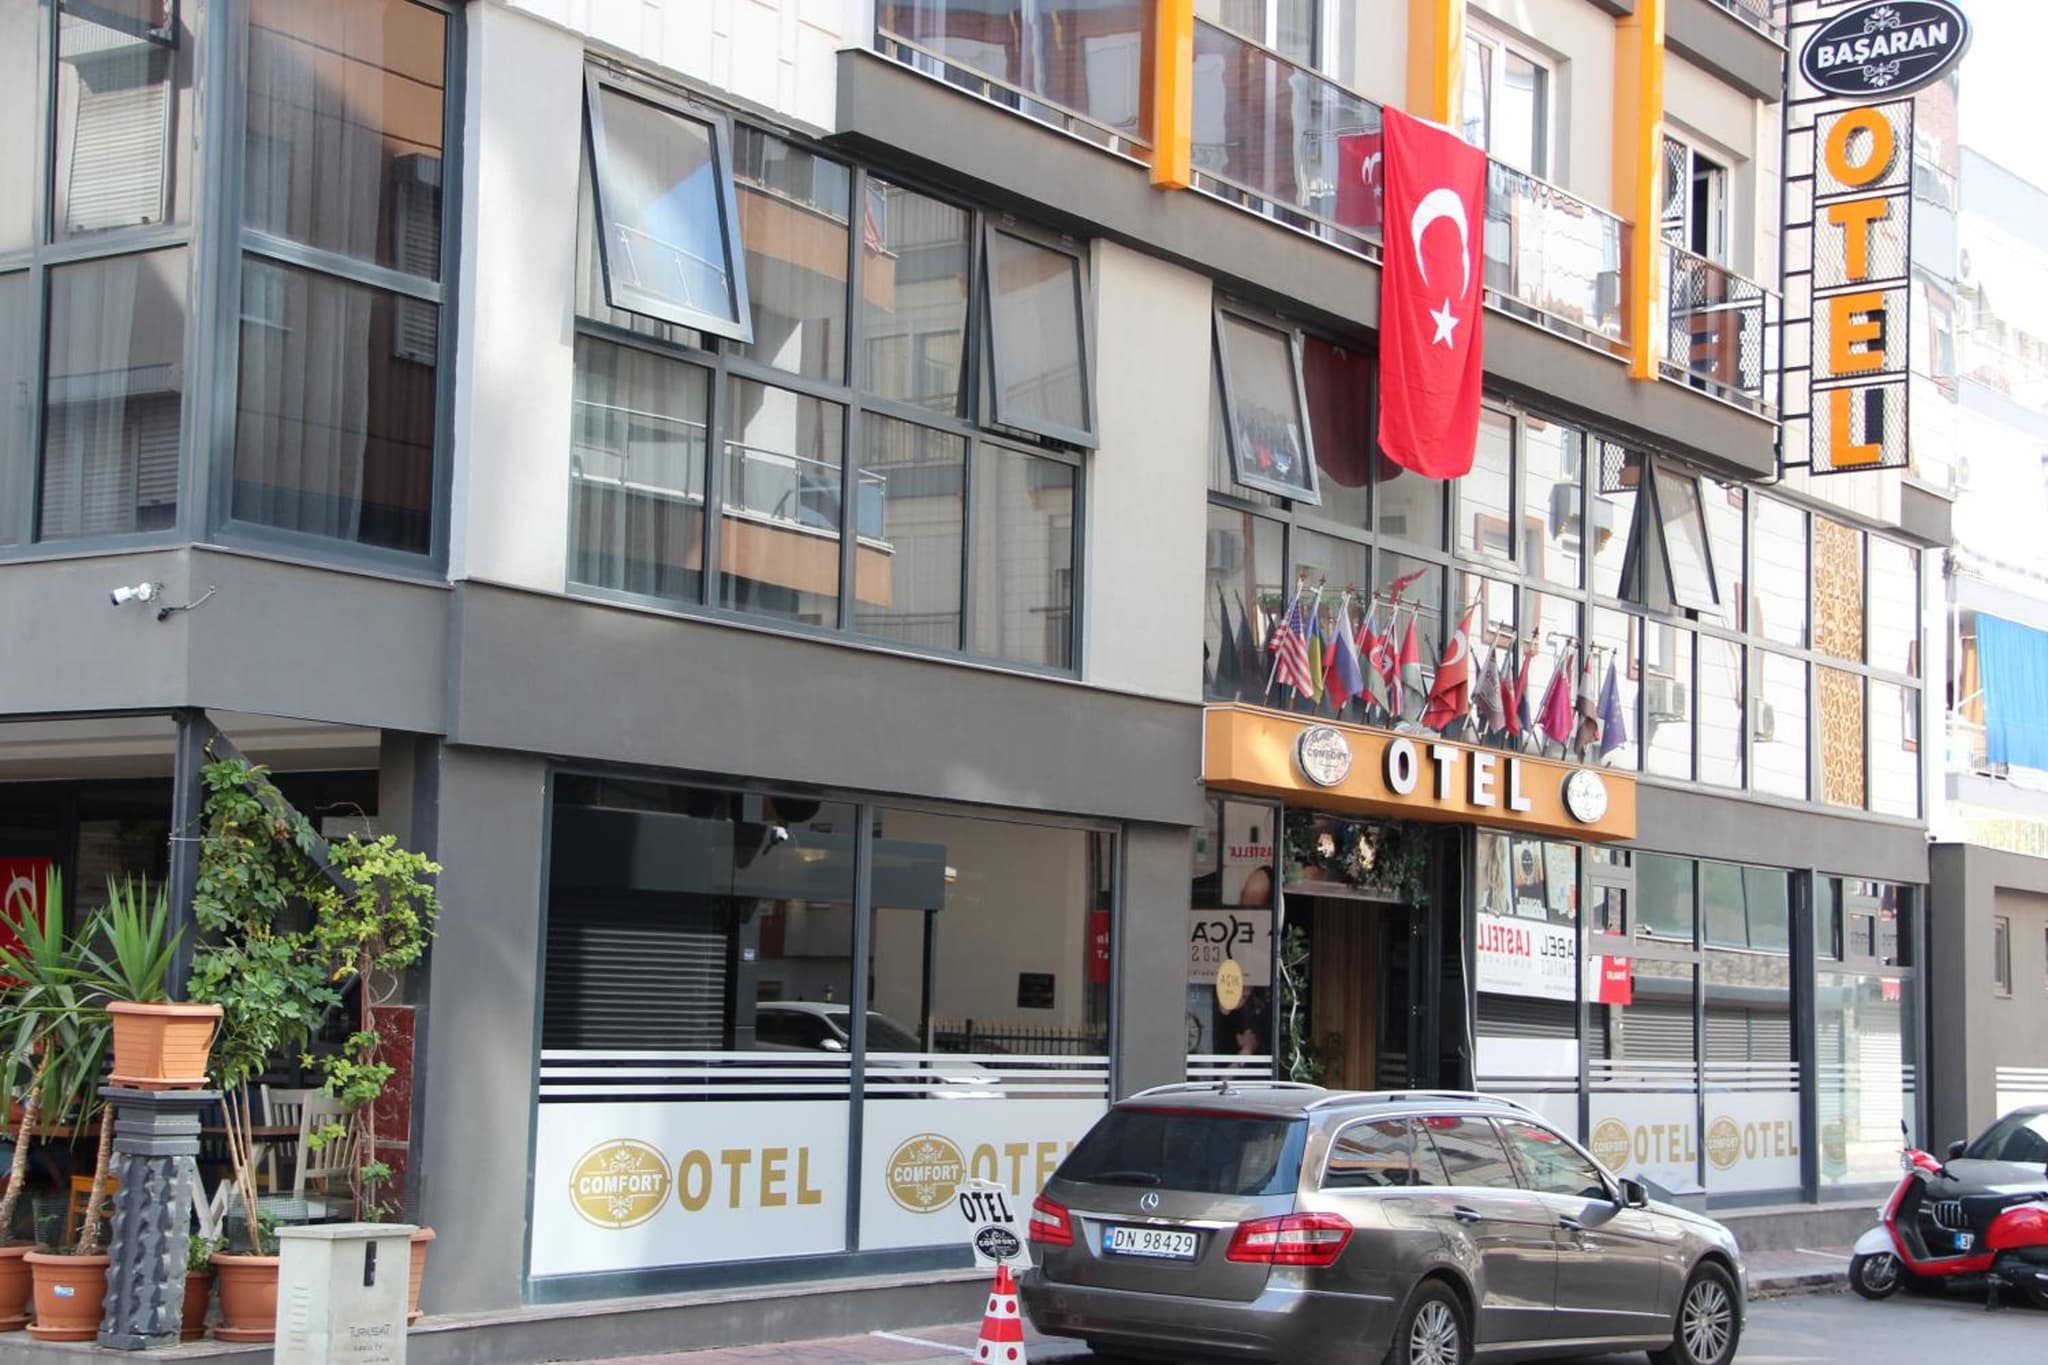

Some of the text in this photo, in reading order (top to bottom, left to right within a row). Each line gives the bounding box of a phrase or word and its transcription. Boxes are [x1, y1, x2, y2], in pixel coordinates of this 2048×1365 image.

[1817, 20, 1949, 70] BAŞARAN
[1825, 106, 1894, 468] OTEL
[1386, 738, 1531, 812] OTEL
[1634, 1124, 1696, 1165] OTEL
[1744, 1120, 1798, 1160] OTEL
[579, 1173, 663, 1194] COMFORT
[678, 1147, 822, 1212] OTEL
[893, 1165, 960, 1183] COMFORT
[970, 1142, 1075, 1196] OTE
[959, 1192, 1014, 1223] OTEL
[1115, 1230, 1193, 1253] DN 98429
